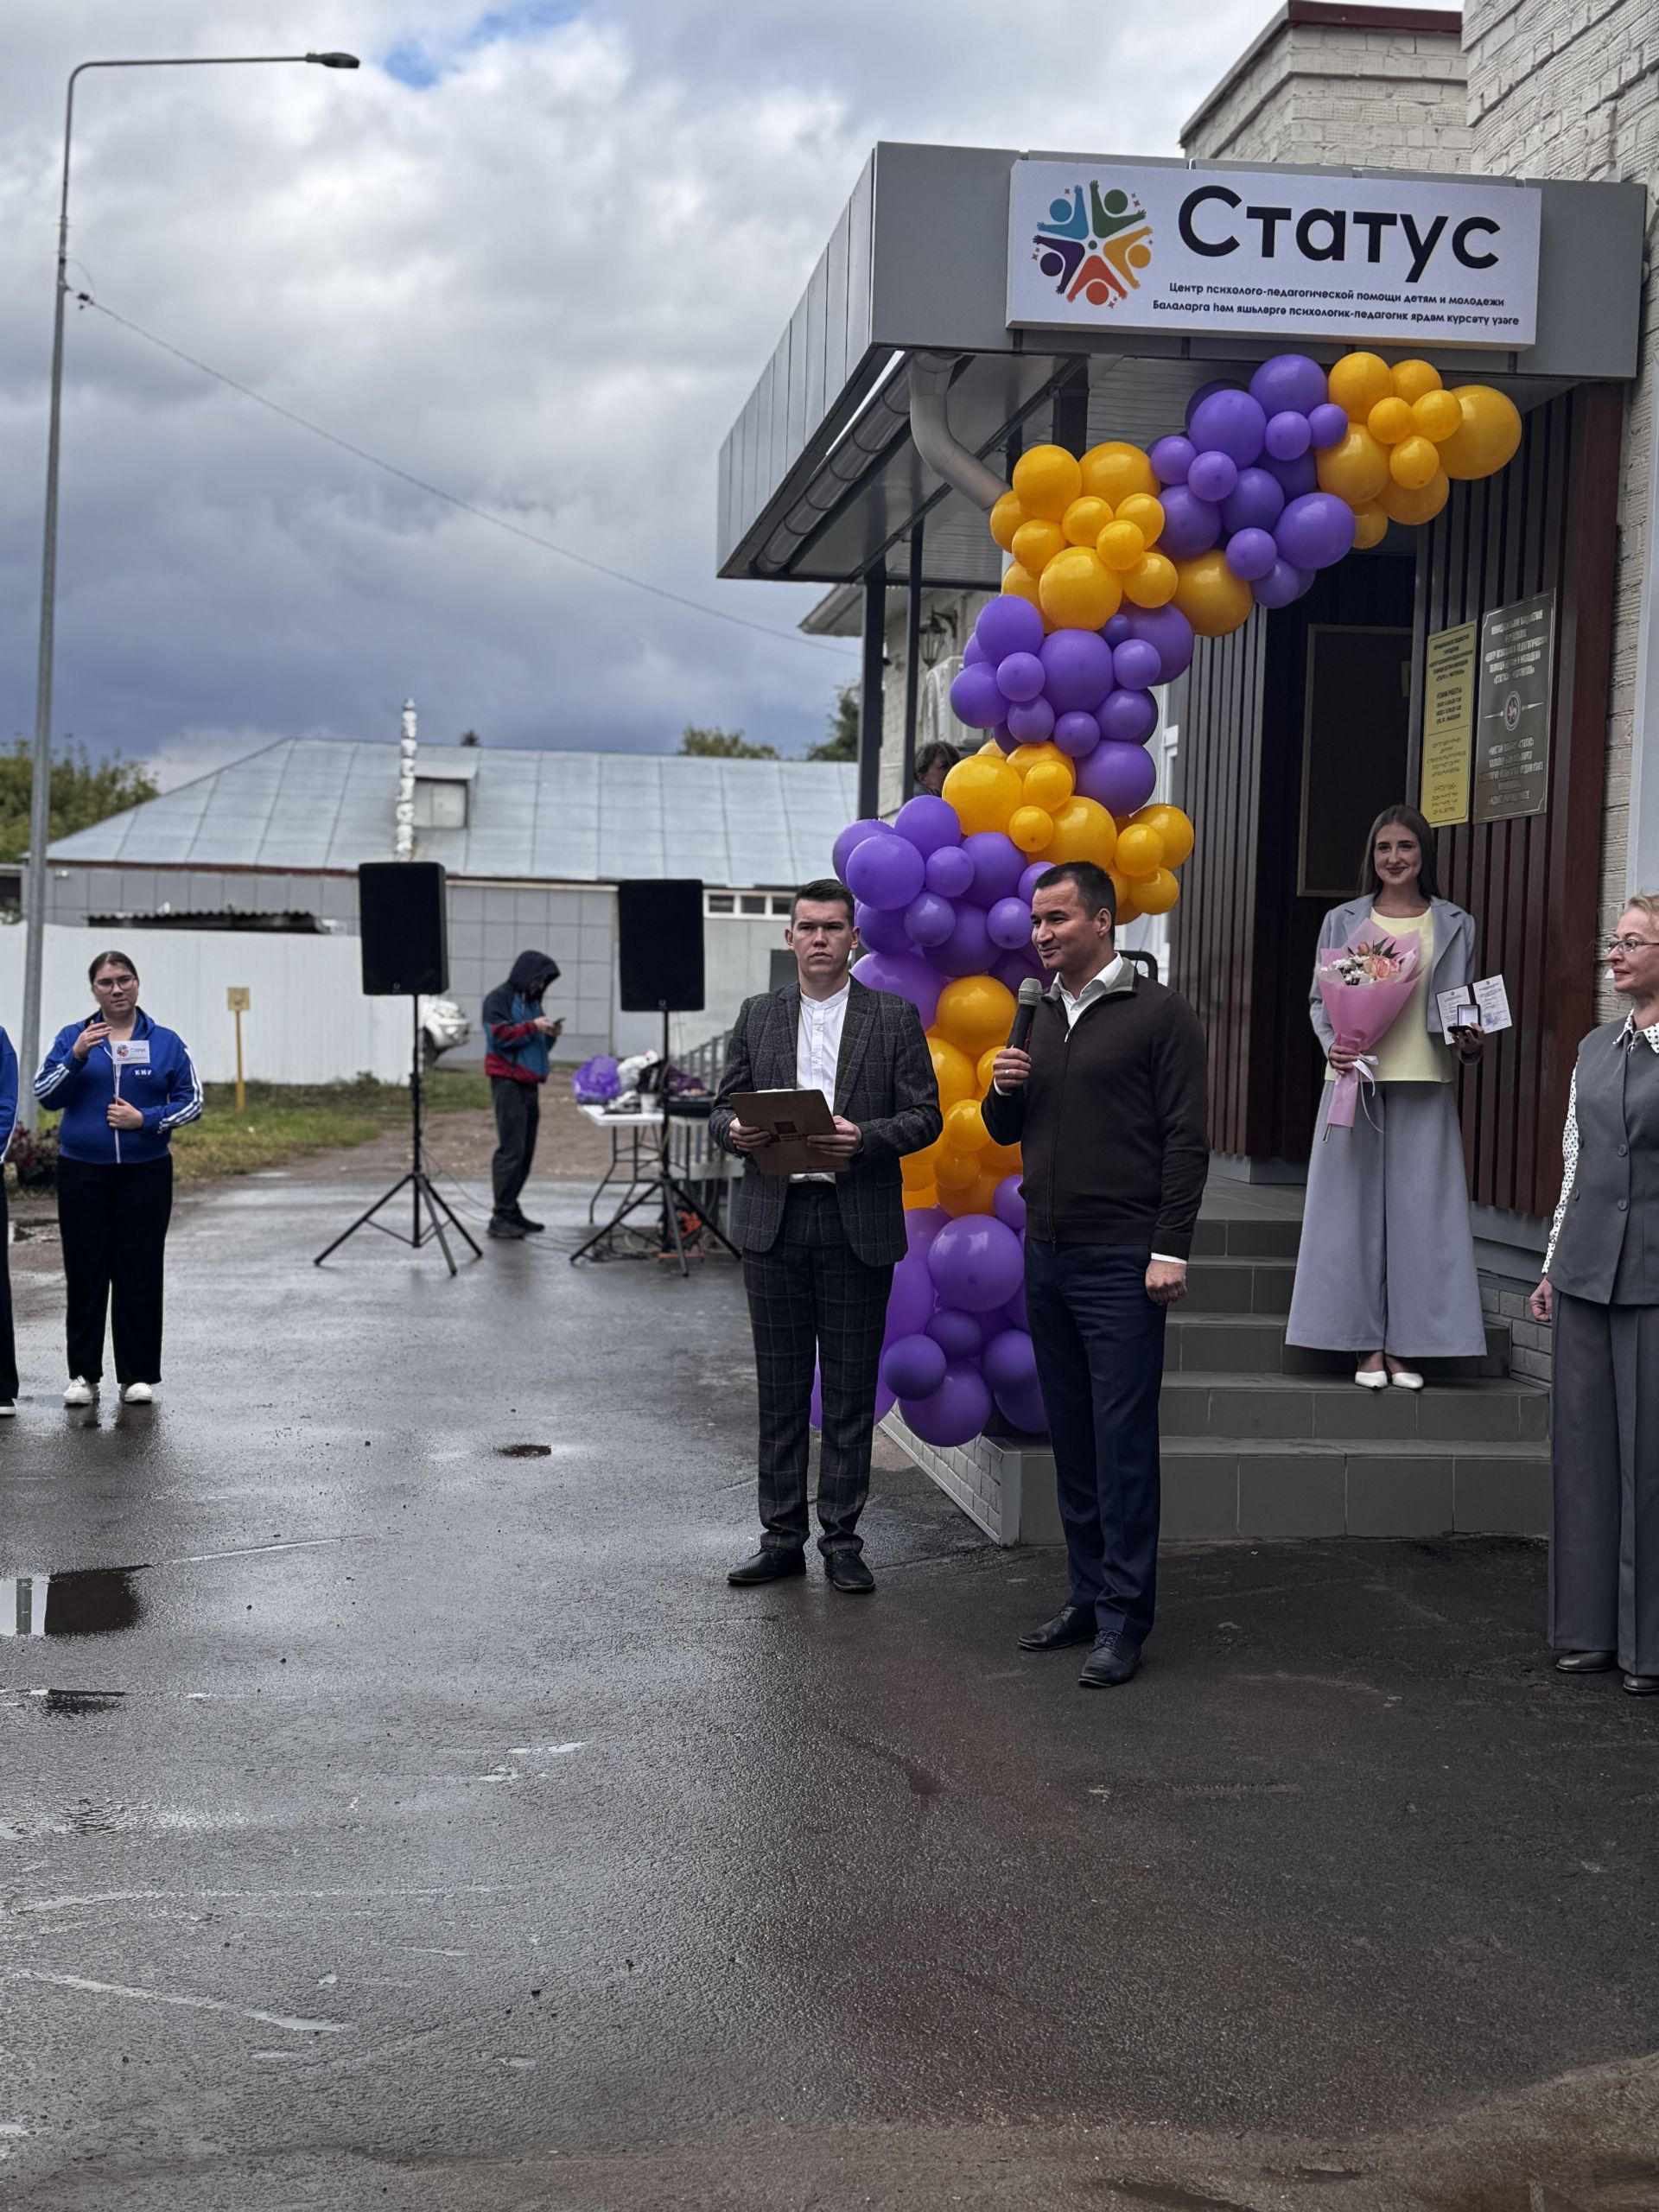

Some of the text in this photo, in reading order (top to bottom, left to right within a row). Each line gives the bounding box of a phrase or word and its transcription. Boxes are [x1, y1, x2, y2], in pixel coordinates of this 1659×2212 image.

[1179, 185, 1501, 283] Статус
[1169, 283, 1204, 295] Центр
[1206, 285, 1354, 300] психолого-педагогической
[1357, 291, 1401, 302] помощи
[1403, 295, 1437, 304] детям
[1448, 296, 1504, 307] молодежи
[1153, 300, 1520, 327] Балаларга һәм яшьләргә психологик-педагогик ярдәм күрсәтү үзәге
